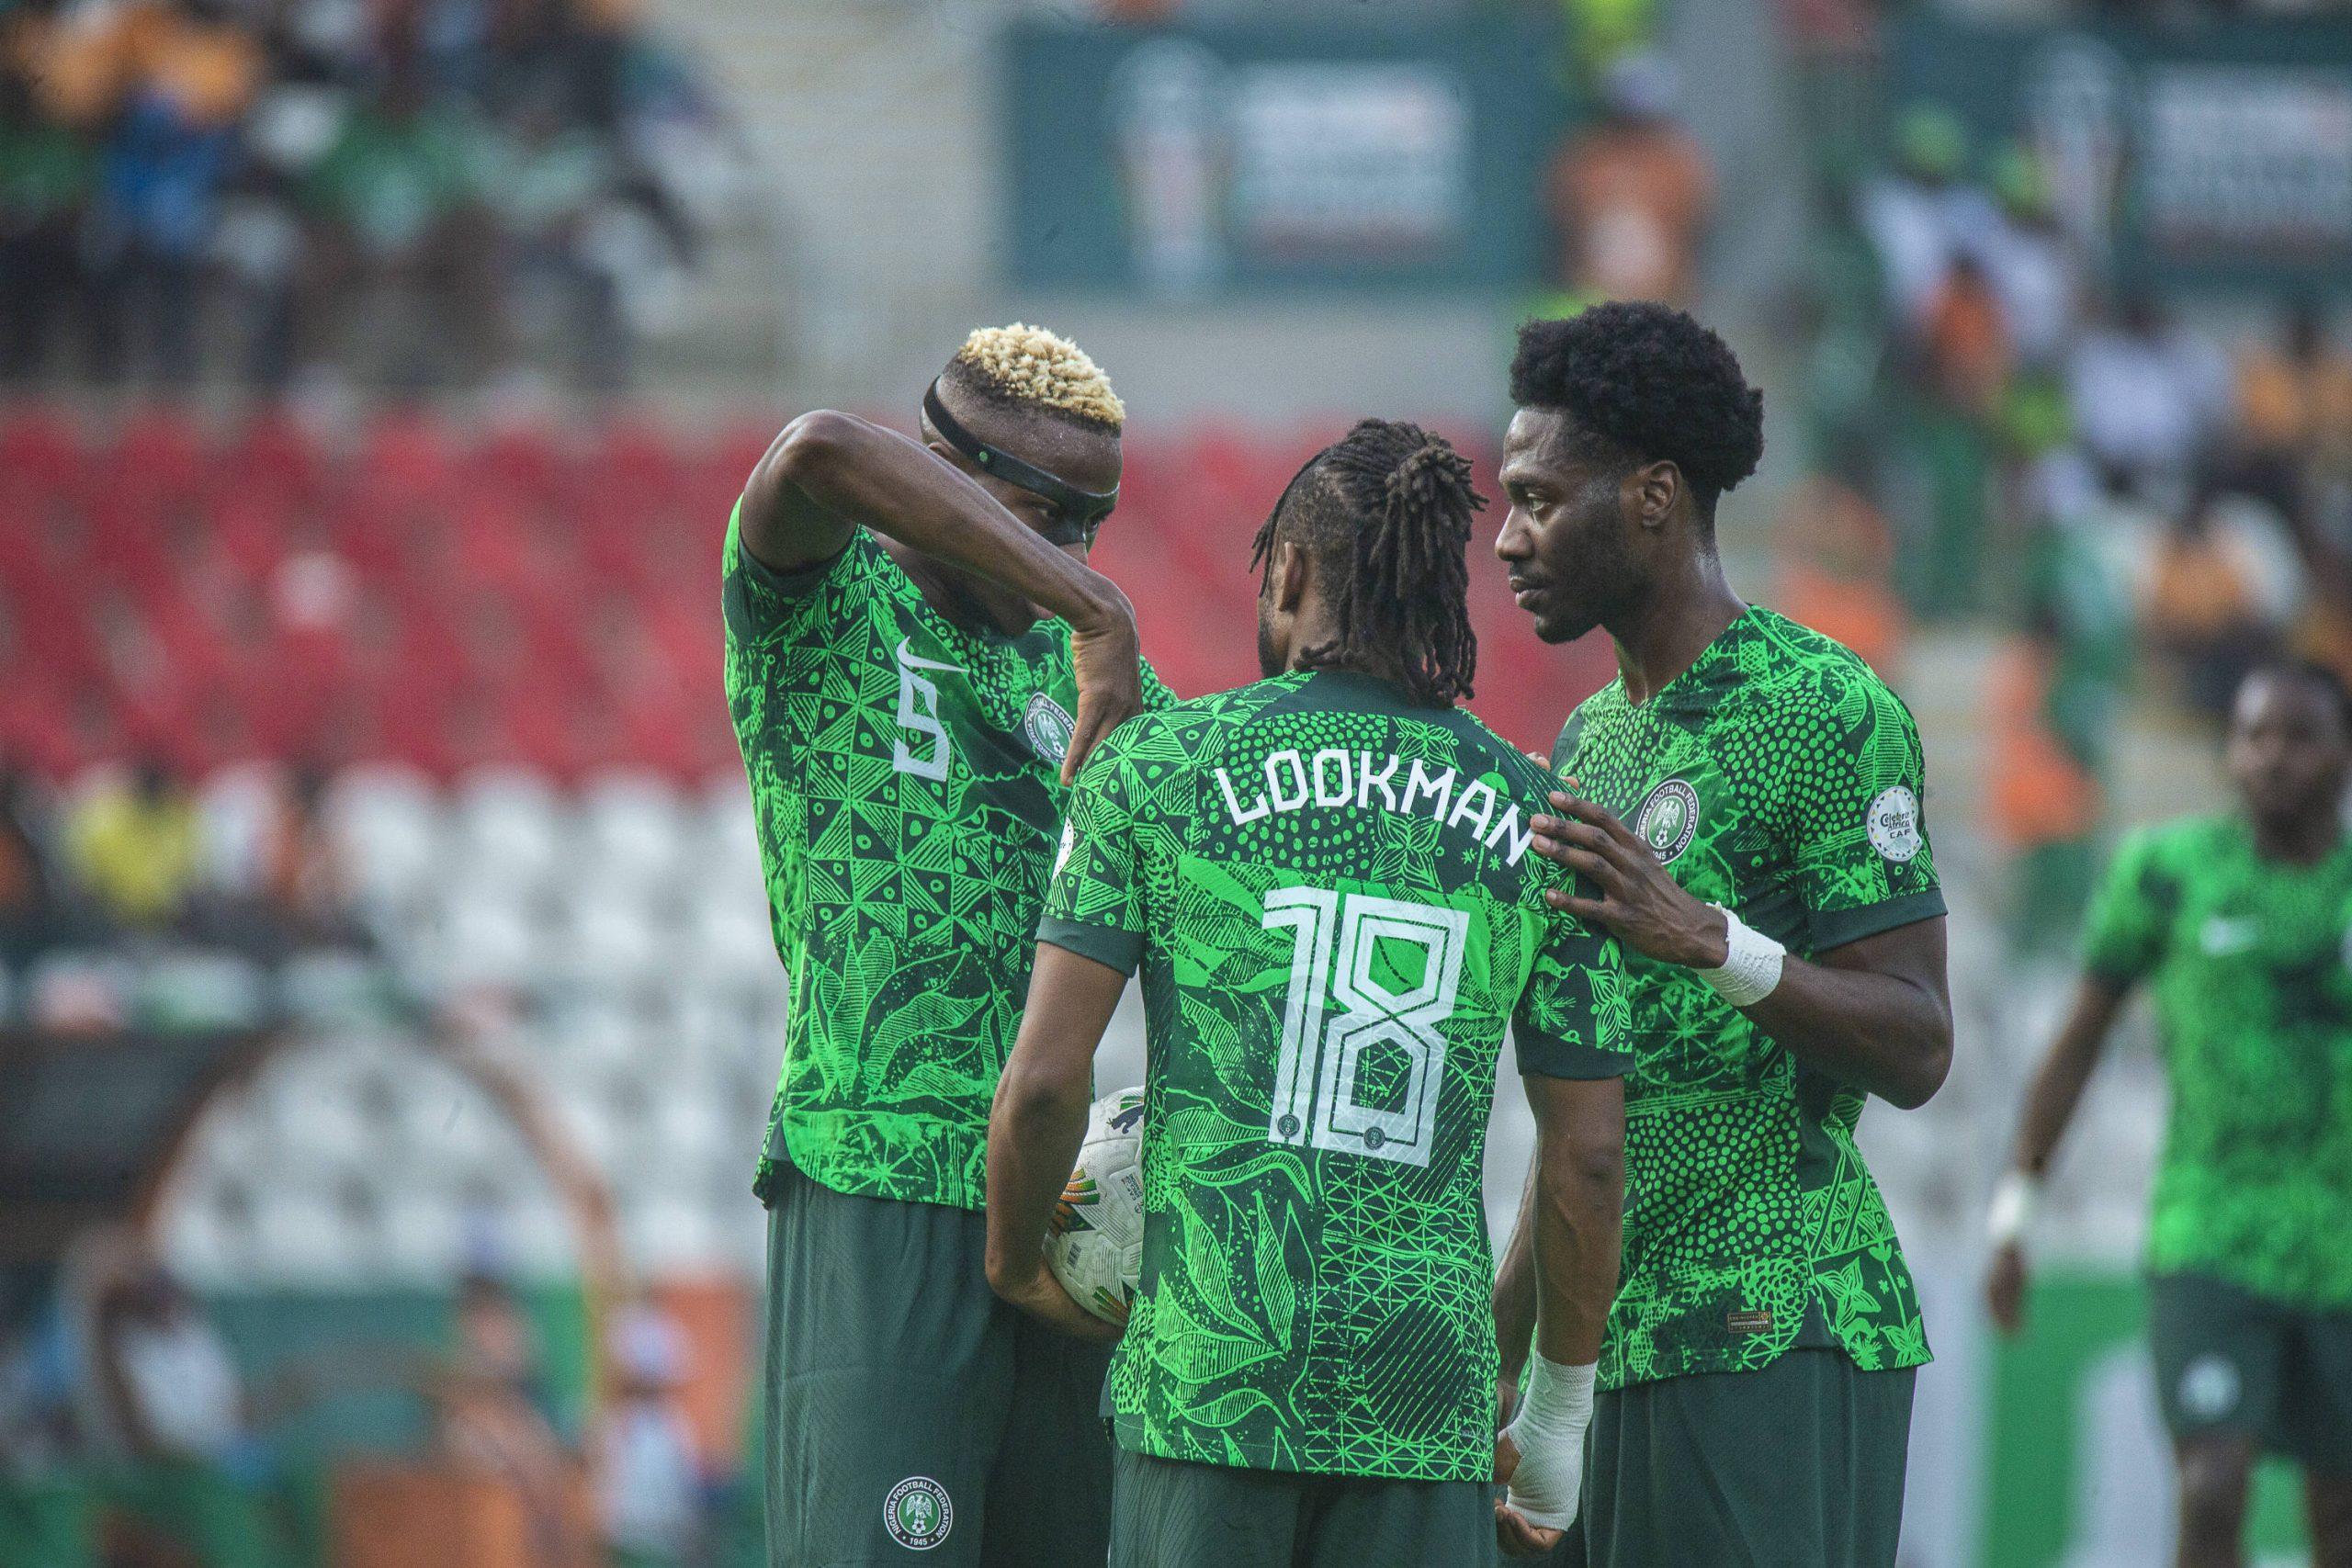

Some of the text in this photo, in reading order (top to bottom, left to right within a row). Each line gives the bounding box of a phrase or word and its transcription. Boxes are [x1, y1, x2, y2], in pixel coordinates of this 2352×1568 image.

[1215, 749, 1538, 868] LOOKMAN
[1650, 784, 1687, 807] FOOTBALL
[1676, 792, 1696, 852] FEDERATION
[1889, 828, 1912, 840] CAF
[1261, 885, 1470, 1168] 18
[888, 1481, 950, 1539] NIGERIA FOOTBALL FEDERATION
[910, 1537, 928, 1546] 1945
